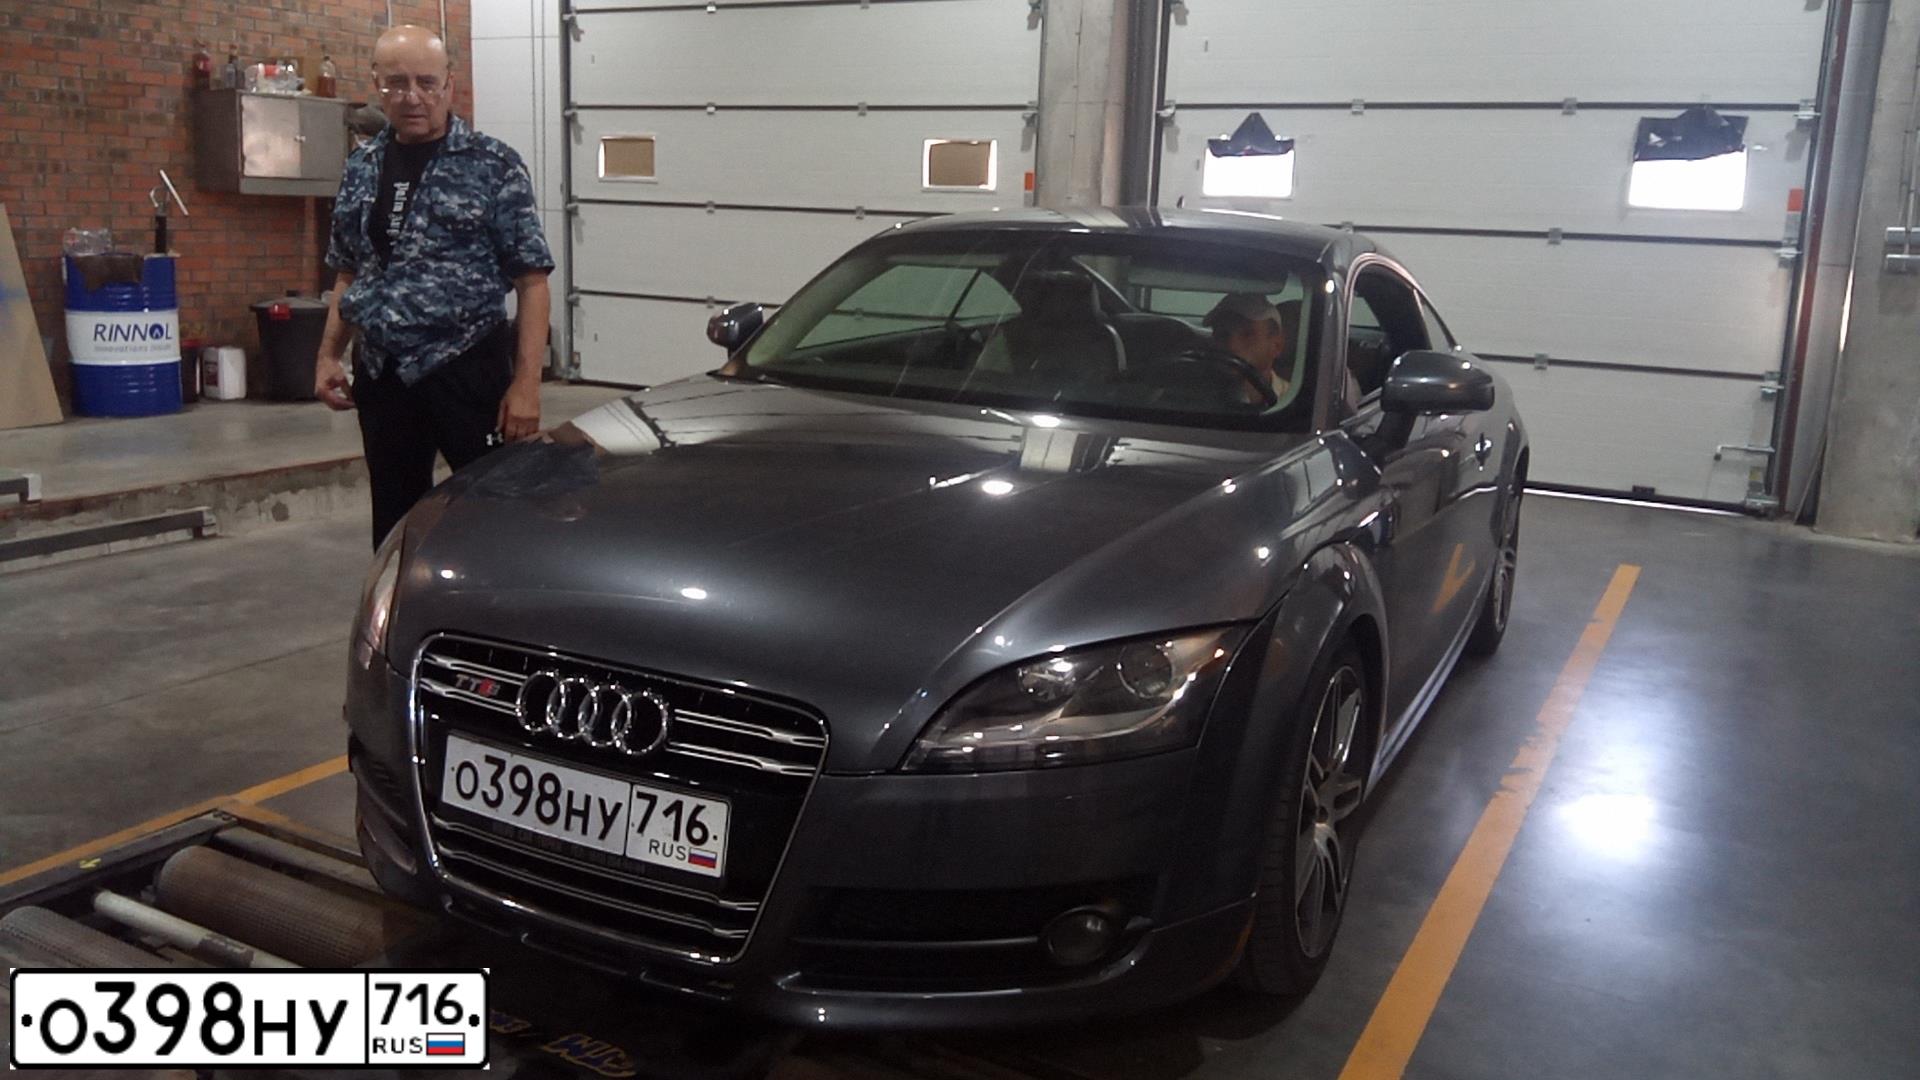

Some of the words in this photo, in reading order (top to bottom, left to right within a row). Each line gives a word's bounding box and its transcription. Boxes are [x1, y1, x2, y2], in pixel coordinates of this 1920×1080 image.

[94, 323, 173, 342] RINNOL
[636, 793, 710, 847] 716
[649, 838, 687, 862] RUS
